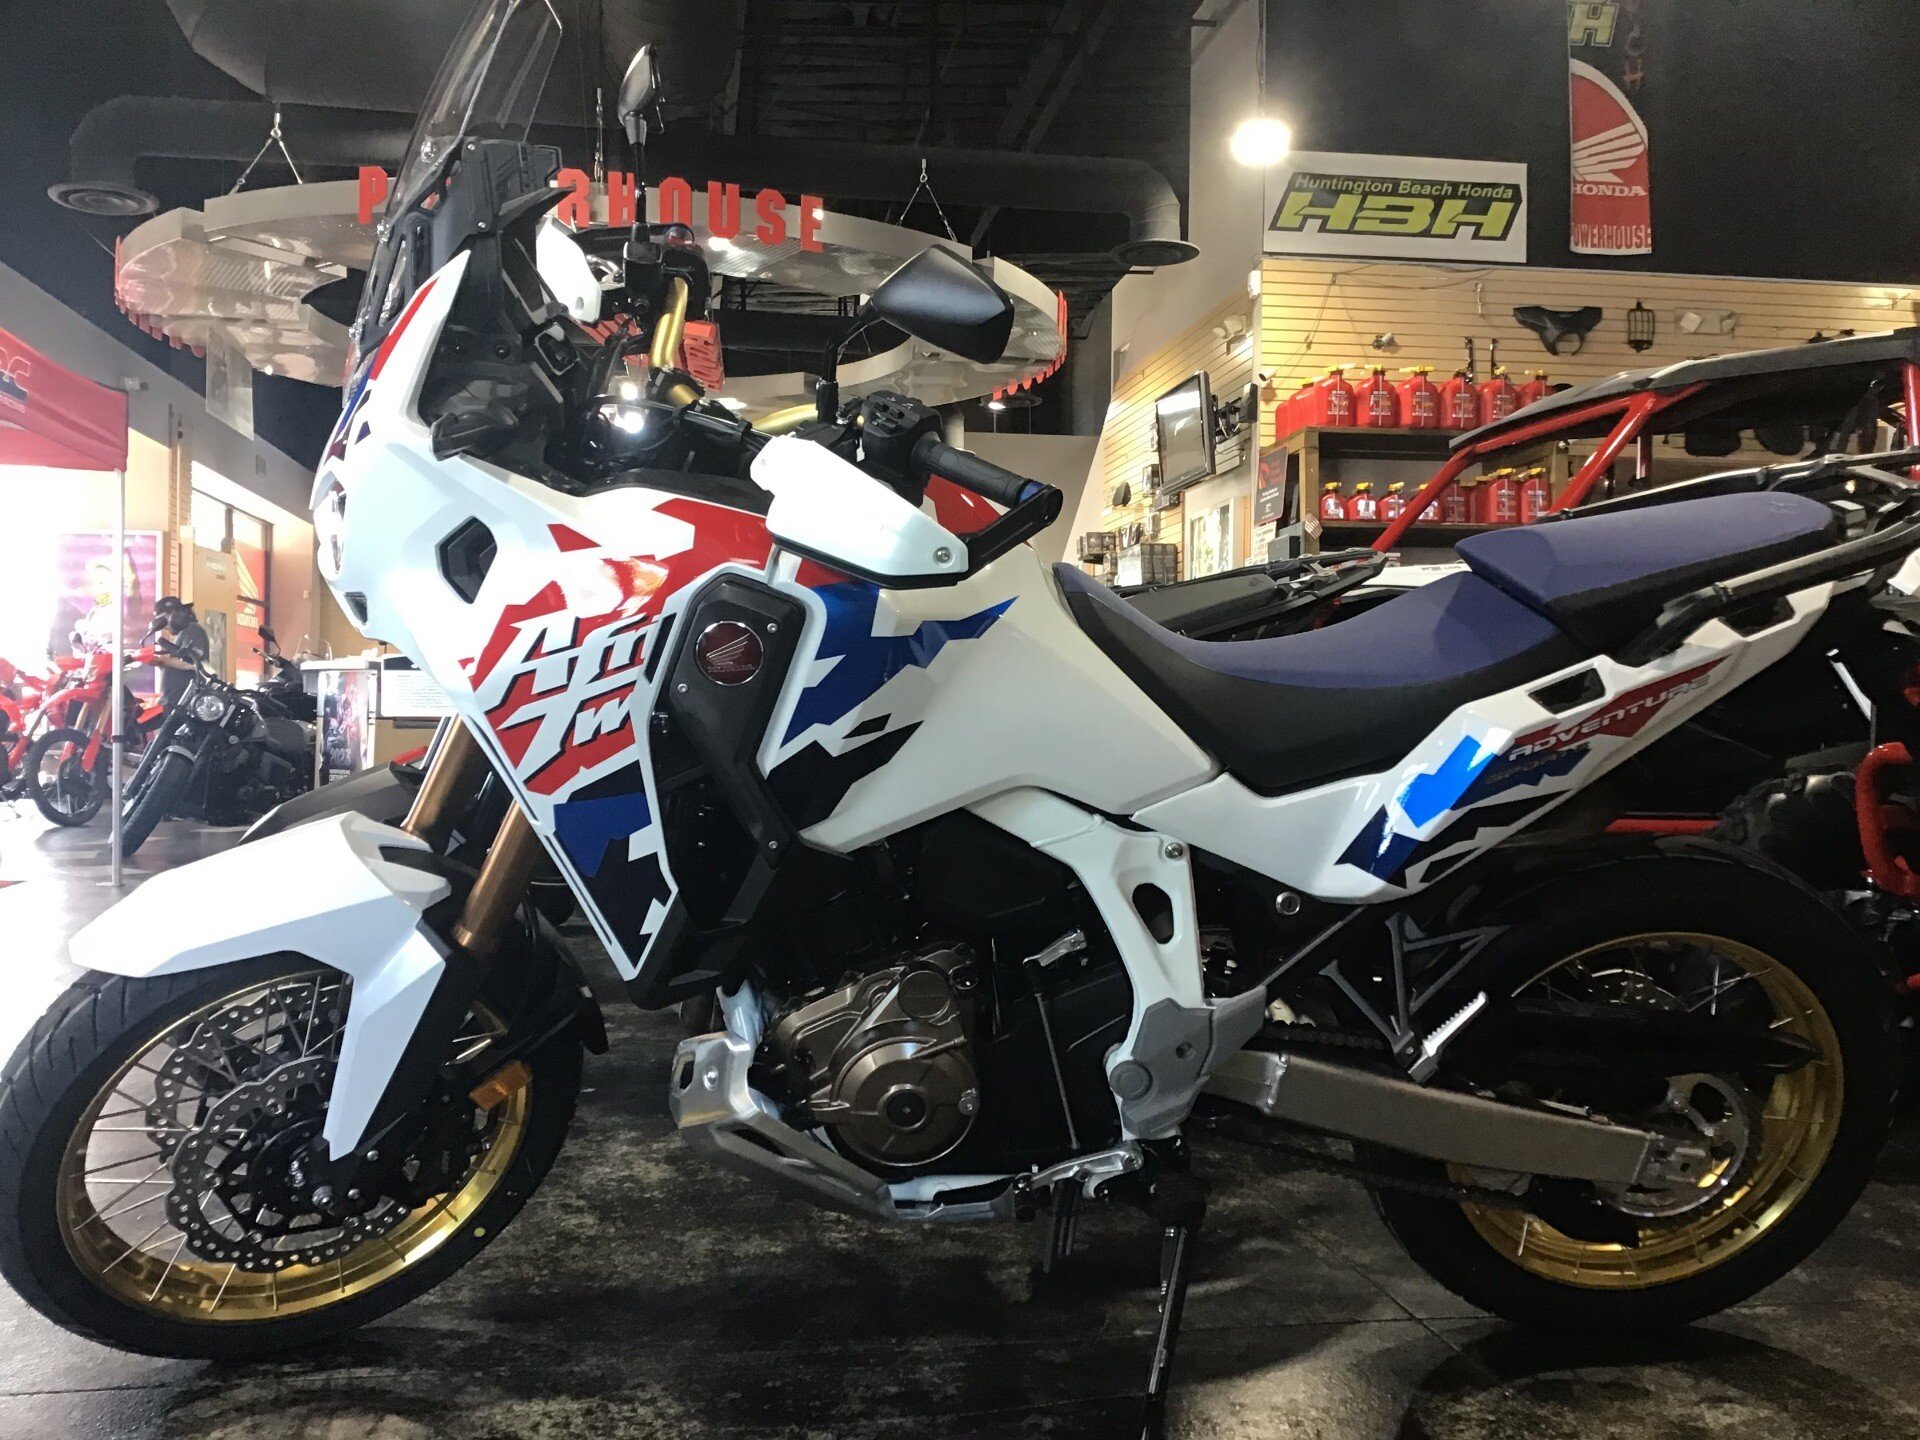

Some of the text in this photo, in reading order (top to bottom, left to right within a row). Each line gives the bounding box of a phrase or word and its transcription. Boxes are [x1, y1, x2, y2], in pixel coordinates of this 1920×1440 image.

[1295, 174, 1514, 200] Huntington Beach Honda
[1571, 184, 1648, 197] HONDA
[358, 165, 824, 252] PRHOUSE
[1276, 191, 1516, 238] HBH
[1571, 223, 1652, 250] OWERHOUSE
